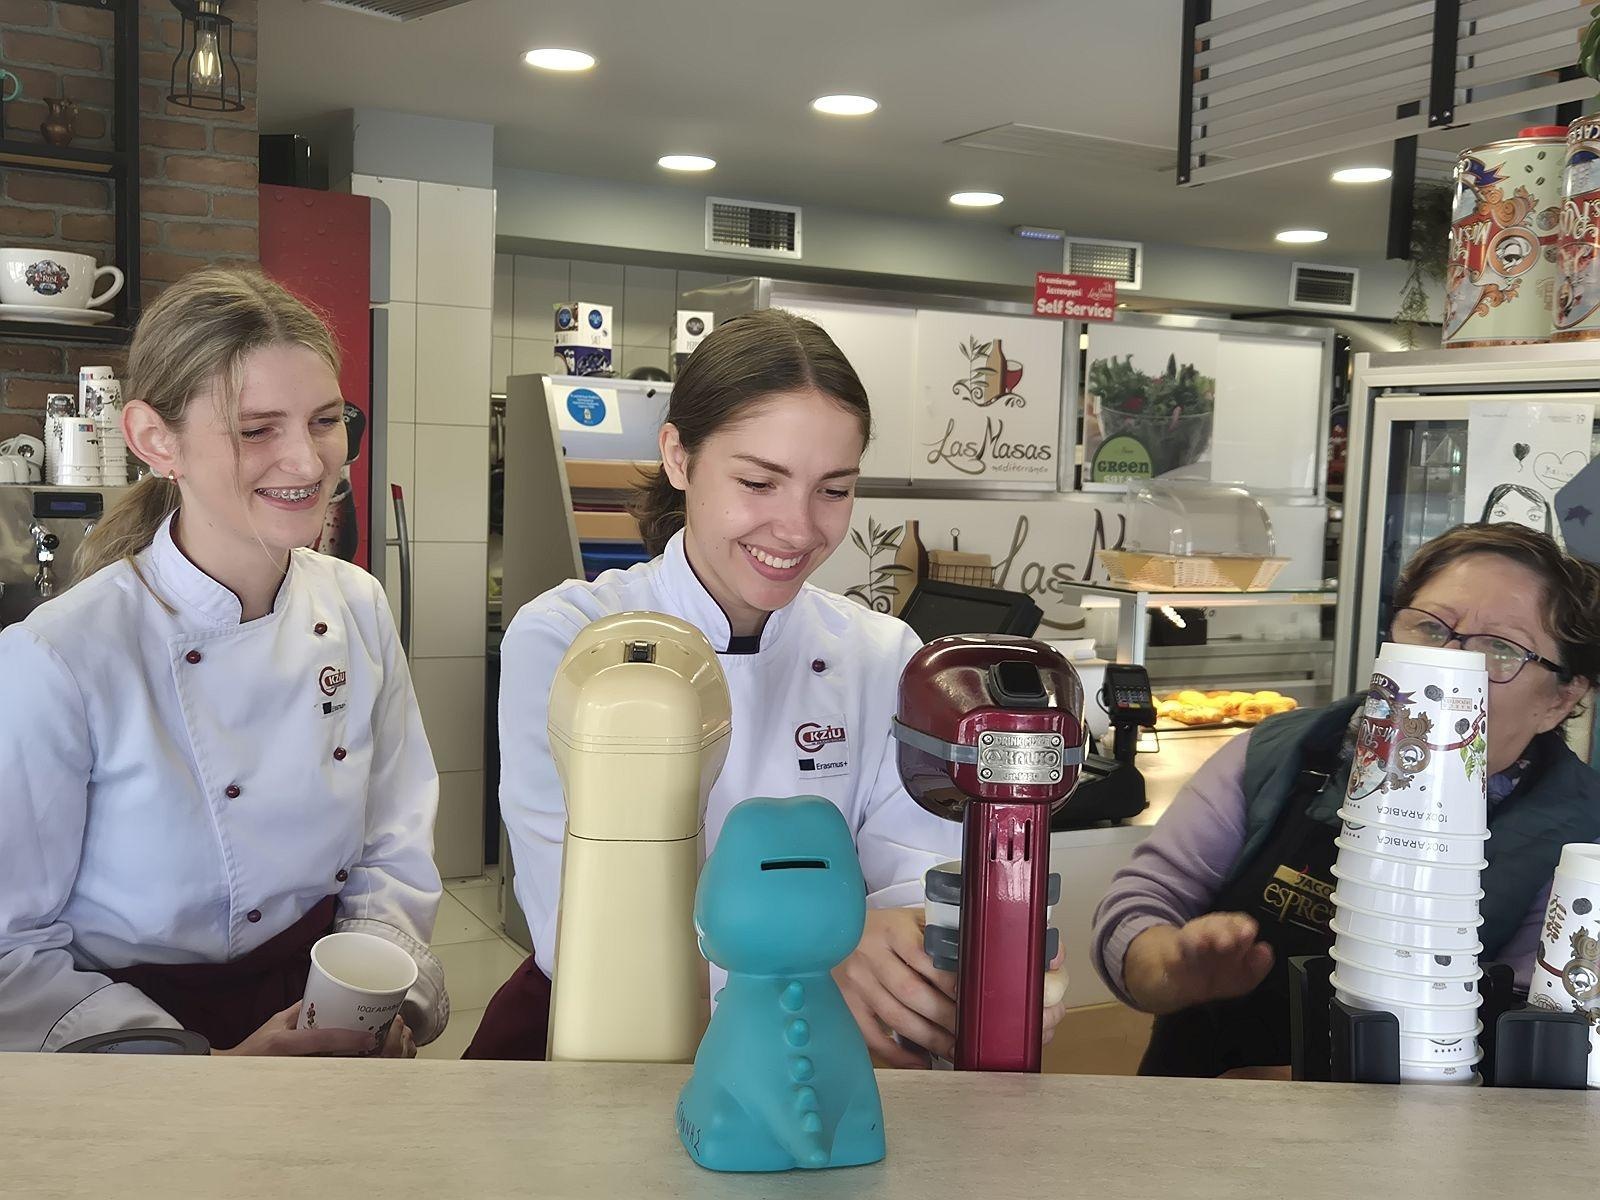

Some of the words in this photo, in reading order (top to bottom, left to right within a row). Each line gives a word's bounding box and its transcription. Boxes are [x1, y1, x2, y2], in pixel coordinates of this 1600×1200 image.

[1037, 298, 1064, 314] Self
[1064, 300, 1113, 318] Service
[922, 418, 981, 470] Las
[816, 761, 848, 770] Erasmus+
